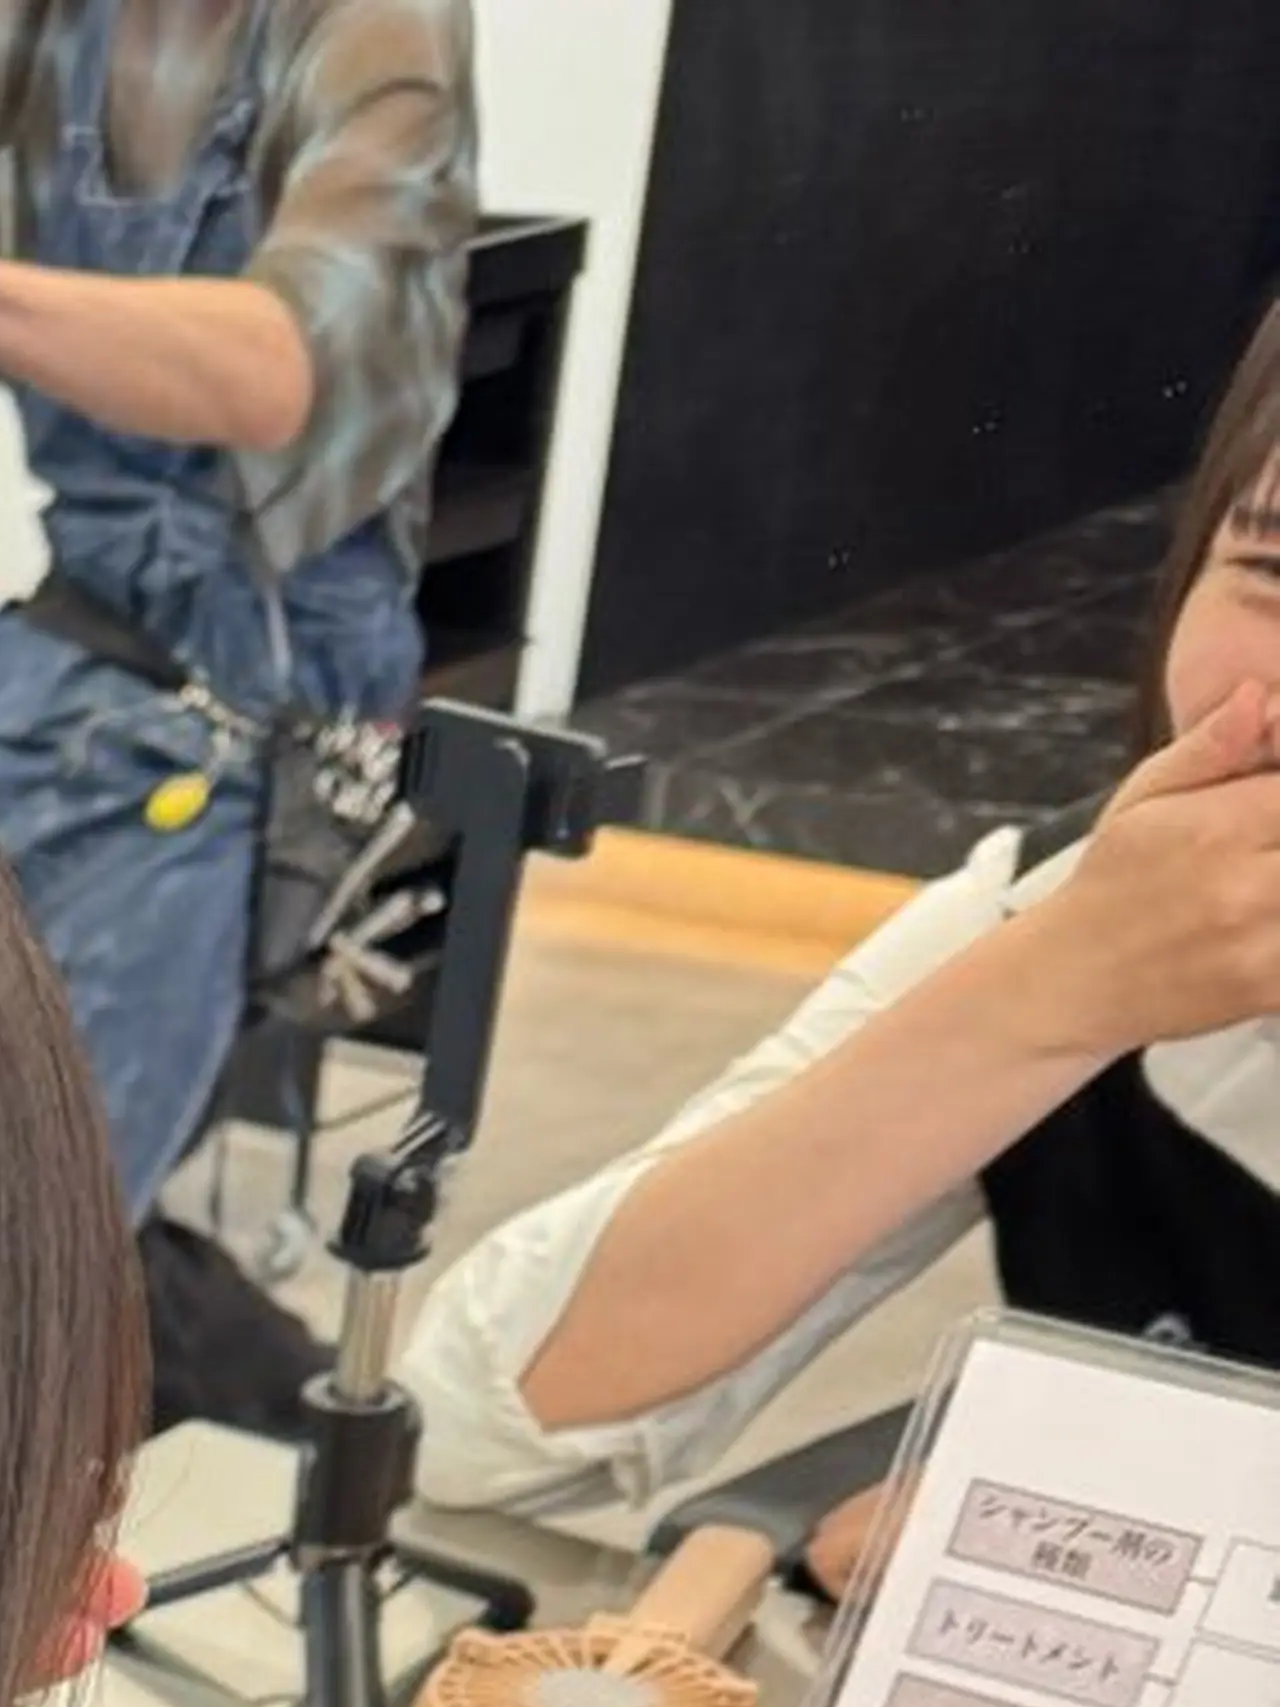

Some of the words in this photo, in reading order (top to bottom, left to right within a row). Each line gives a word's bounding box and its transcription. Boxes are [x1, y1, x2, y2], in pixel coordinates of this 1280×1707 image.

[938, 1608, 1122, 1682] トリートメント
